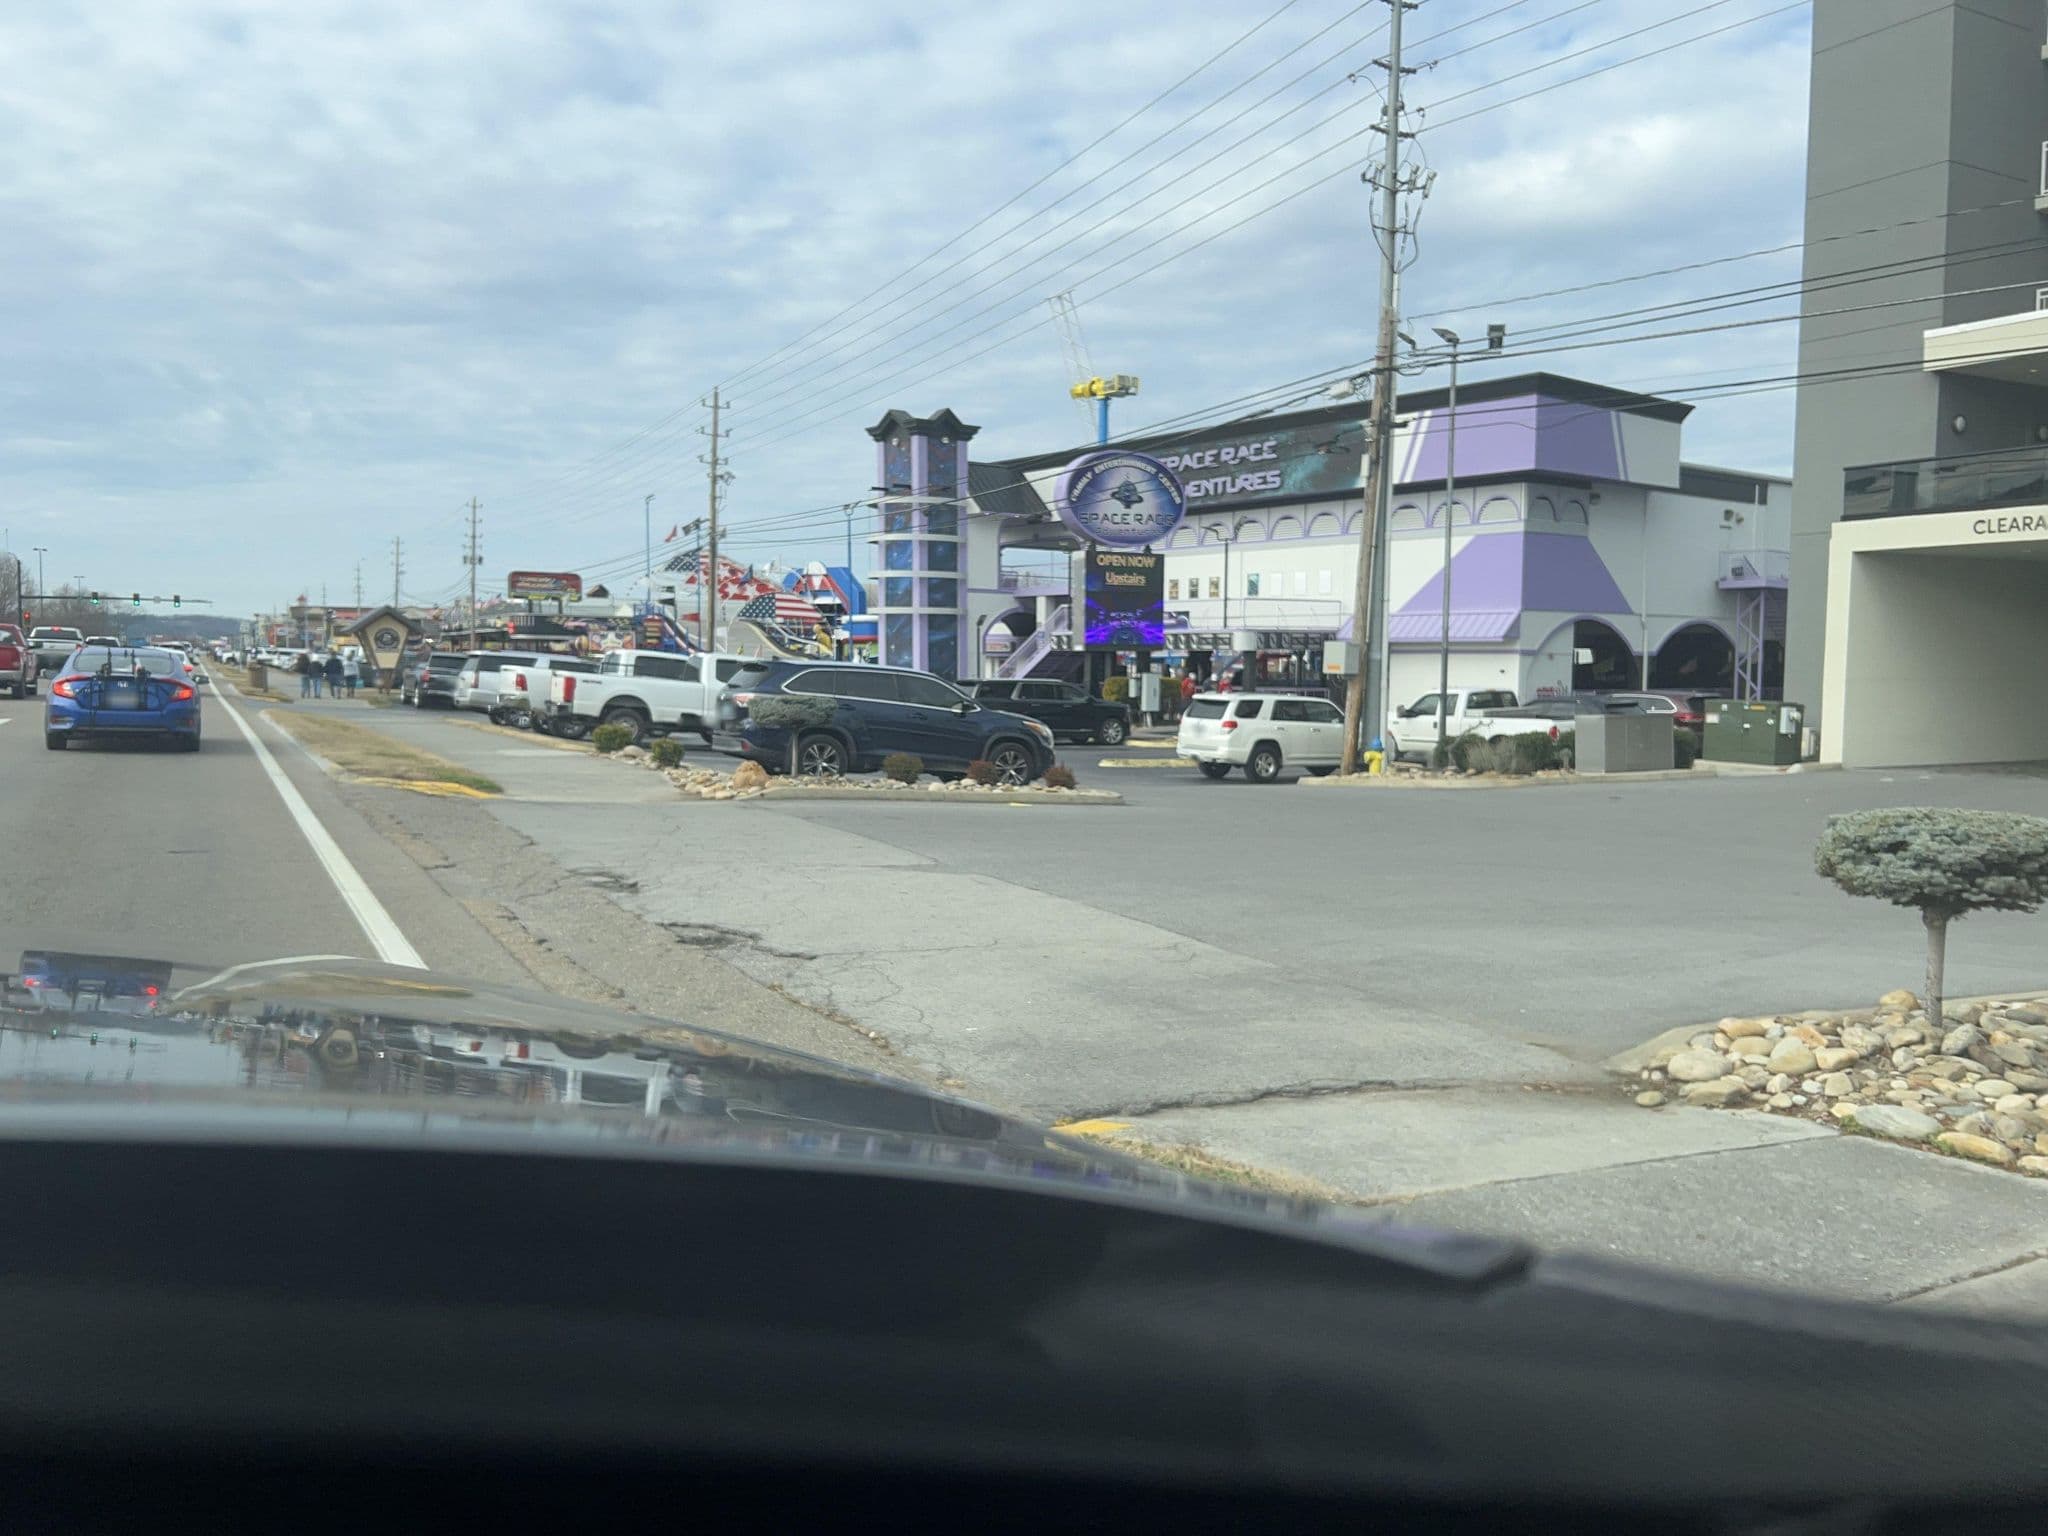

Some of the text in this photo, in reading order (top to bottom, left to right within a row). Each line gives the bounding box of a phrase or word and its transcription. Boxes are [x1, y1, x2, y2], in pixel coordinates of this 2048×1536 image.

[1220, 440, 1278, 465] RACE
[1079, 512, 1177, 527] SPACE RACE
[1096, 554, 1157, 569] OPEN NOW
[1105, 571, 1147, 586] Upstairs
